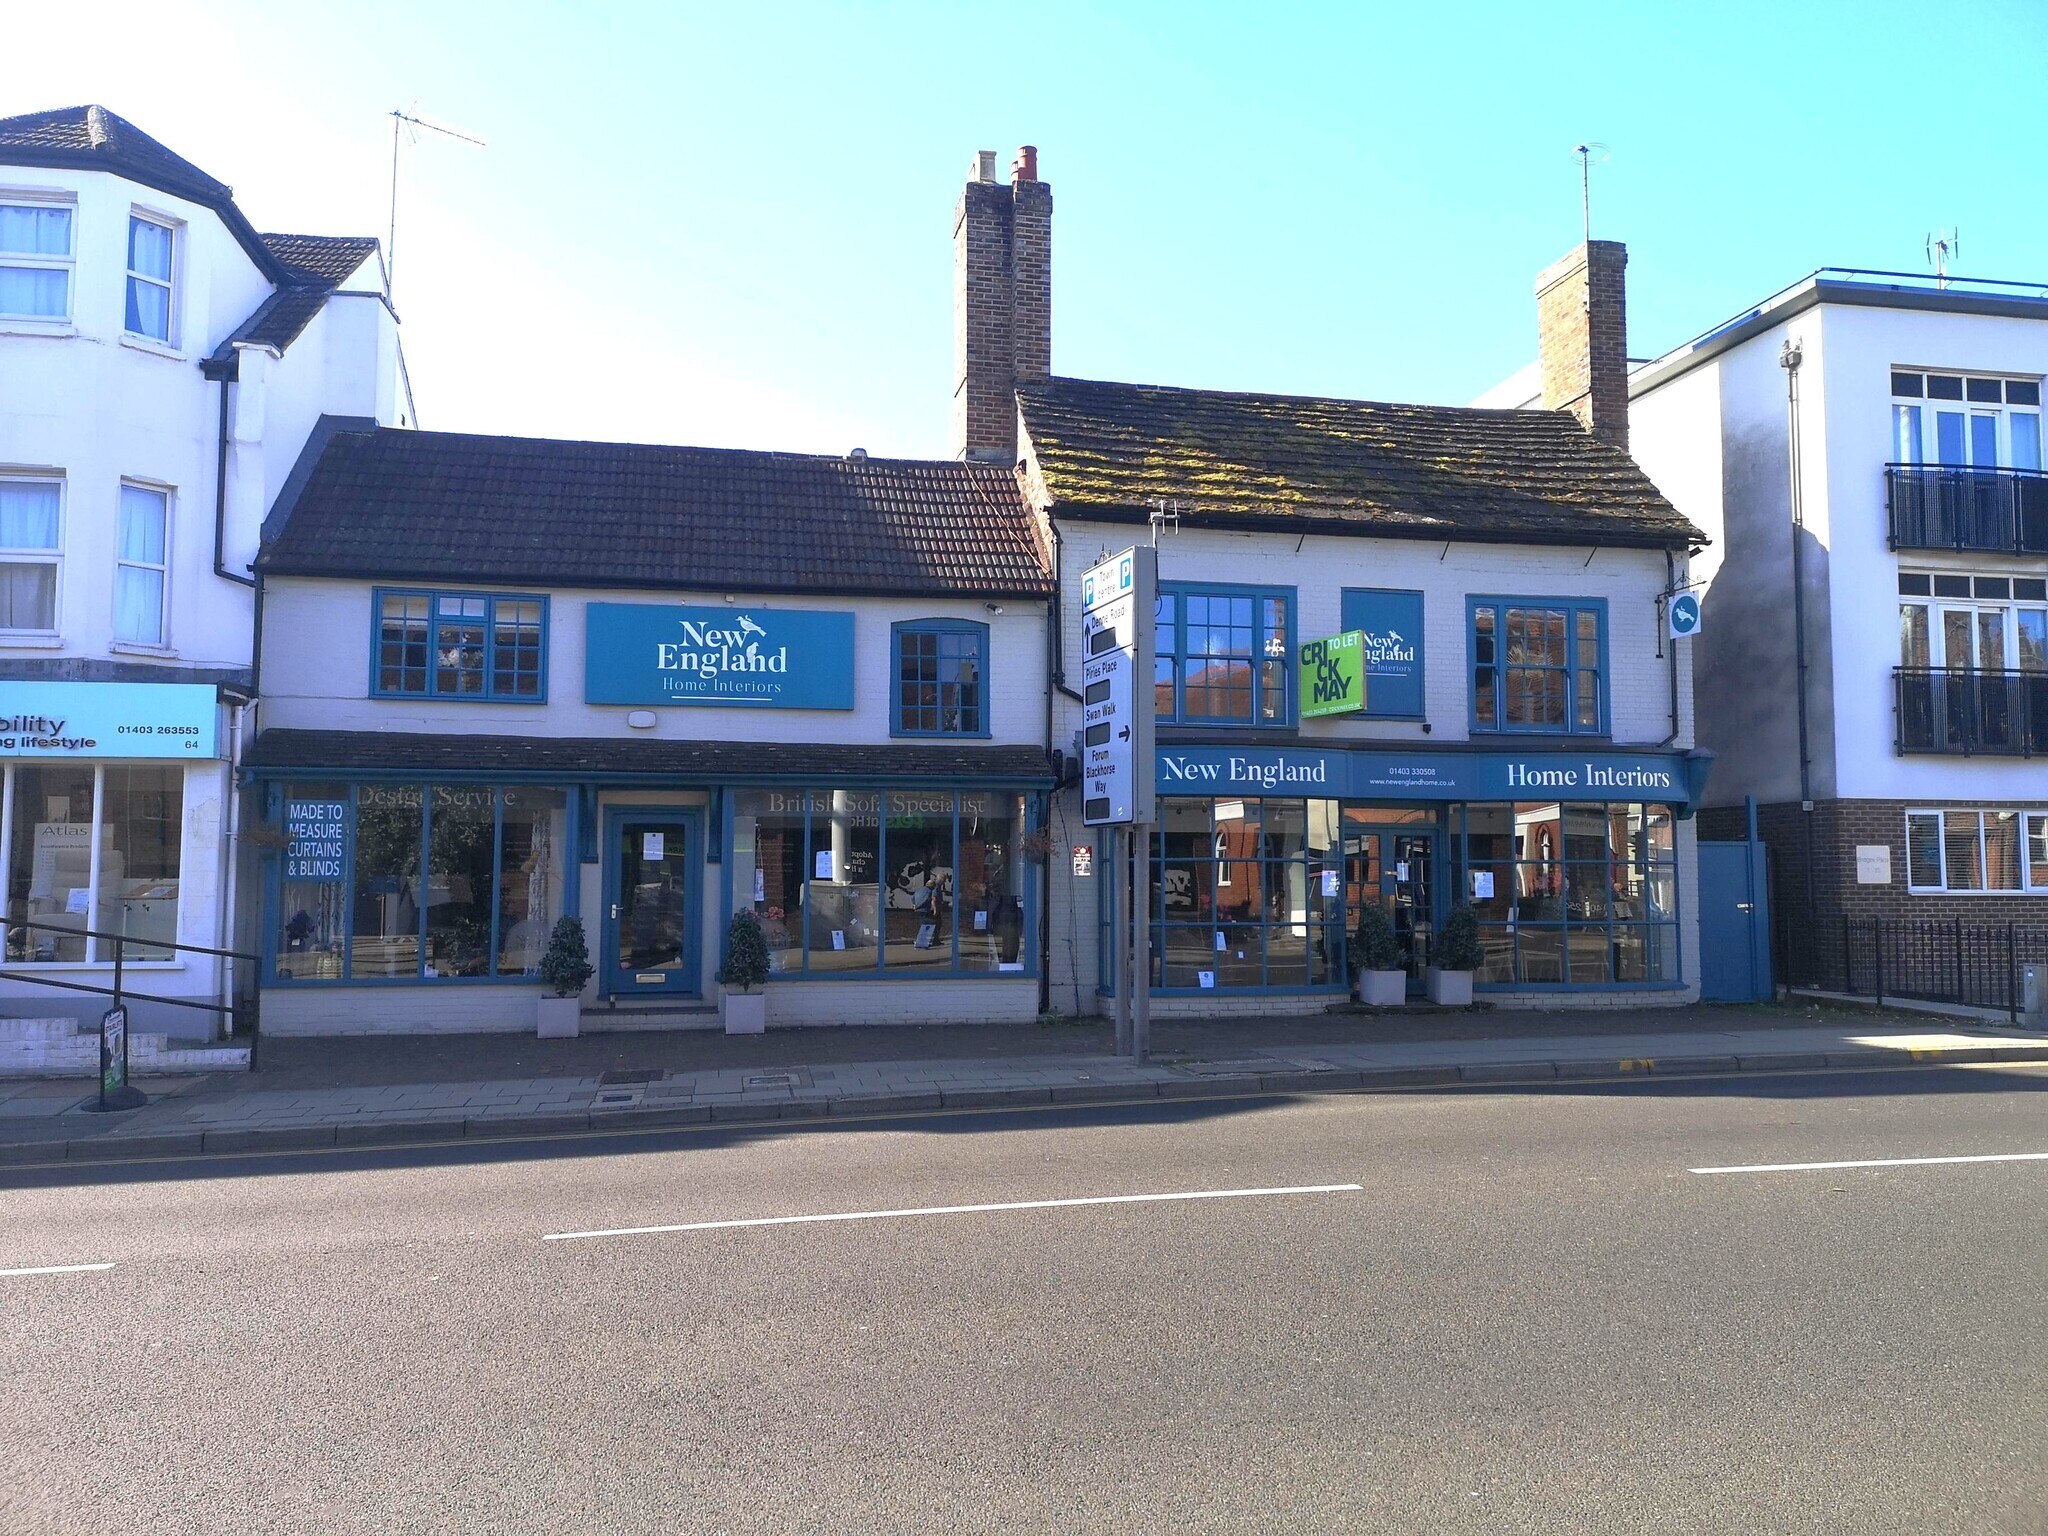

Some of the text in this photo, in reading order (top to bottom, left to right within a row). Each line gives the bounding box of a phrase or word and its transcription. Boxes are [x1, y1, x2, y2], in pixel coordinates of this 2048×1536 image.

[1099, 569, 1114, 582] Town
[679, 621, 749, 648] New
[1328, 633, 1359, 651] TO LET
[1364, 632, 1393, 647] New
[657, 644, 787, 679] England
[1364, 646, 1413, 664] ngland
[1102, 661, 1117, 675] Place
[1378, 664, 1412, 672] Interiors
[663, 677, 781, 693] Home Interiors
[1086, 702, 1117, 721] Swan Walk
[118, 726, 199, 735] 01403 263553
[21, 737, 96, 750] lifestyle
[185, 740, 198, 749] 64
[1092, 750, 1110, 762] Forum
[1086, 764, 1115, 779] Blackhorse
[1162, 757, 1326, 789] New England
[1389, 767, 1436, 776] 01403 330508
[1507, 764, 1670, 788] Home Interiors
[1095, 780, 1106, 794] Way
[1369, 778, 1456, 787] www.newenglandhome.co.uk
[290, 804, 343, 820] MADE TO
[893, 793, 984, 817] Speciaist
[42, 826, 88, 836] Atlas
[289, 823, 343, 838] MEASURE
[287, 841, 342, 858] CURTAINS
[288, 860, 340, 876] & BLINDS
